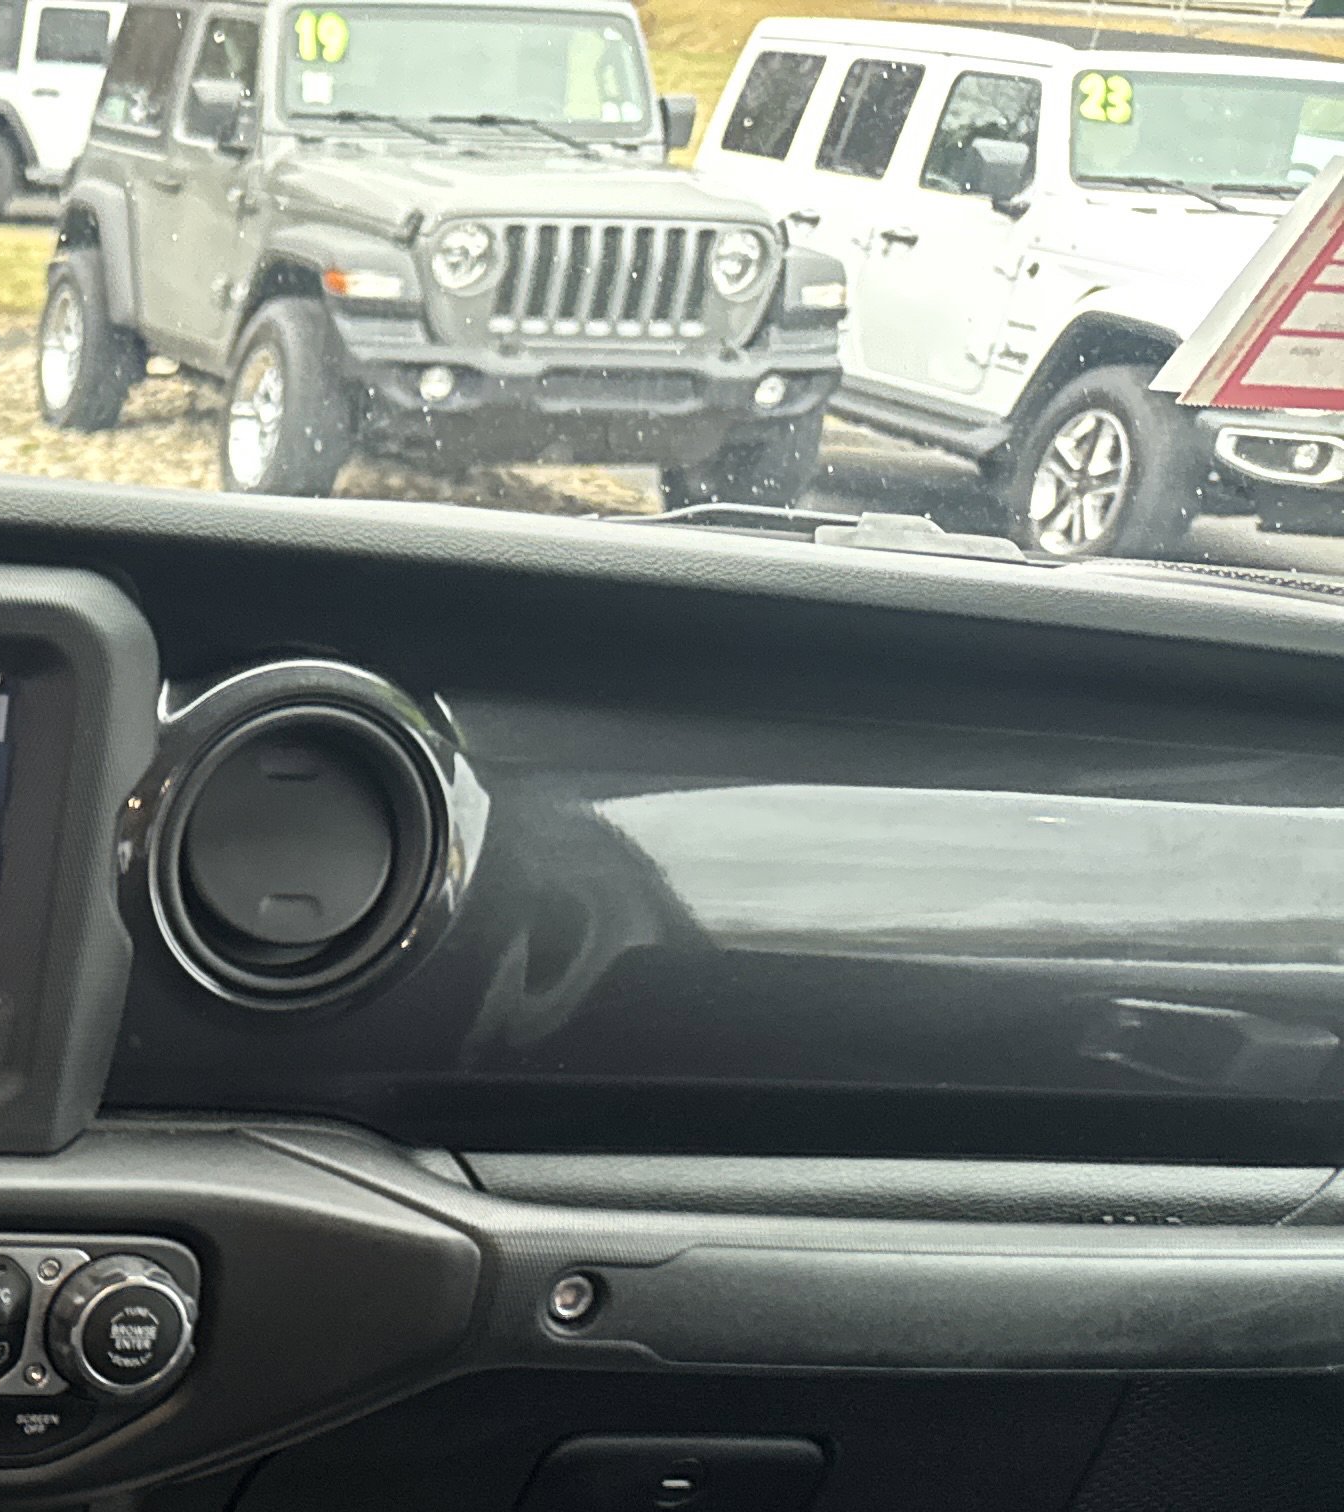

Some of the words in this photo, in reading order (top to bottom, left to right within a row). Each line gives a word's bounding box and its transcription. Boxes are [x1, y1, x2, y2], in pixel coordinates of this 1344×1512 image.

[295, 10, 349, 62] 19
[1079, 72, 1132, 124] 23
[16, 1413, 60, 1425] SCREEN
